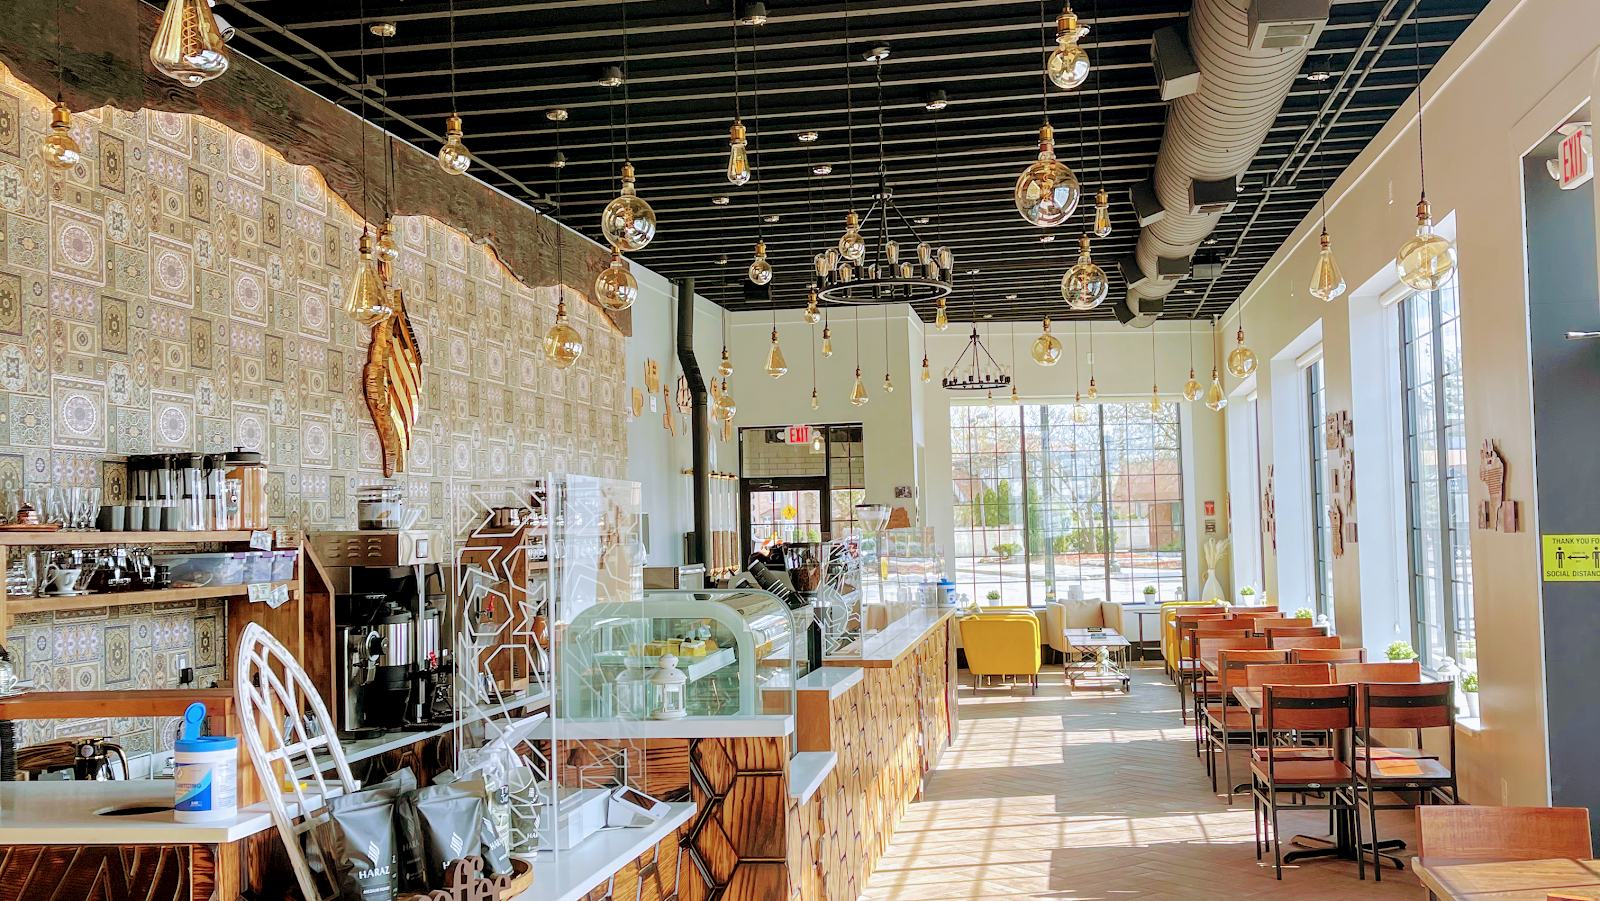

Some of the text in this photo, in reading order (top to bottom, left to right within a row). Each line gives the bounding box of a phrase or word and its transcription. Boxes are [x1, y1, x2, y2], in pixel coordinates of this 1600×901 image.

[1563, 130, 1583, 183] EXIT
[790, 427, 809, 443] EXIT
[358, 866, 390, 879] HARAZ
